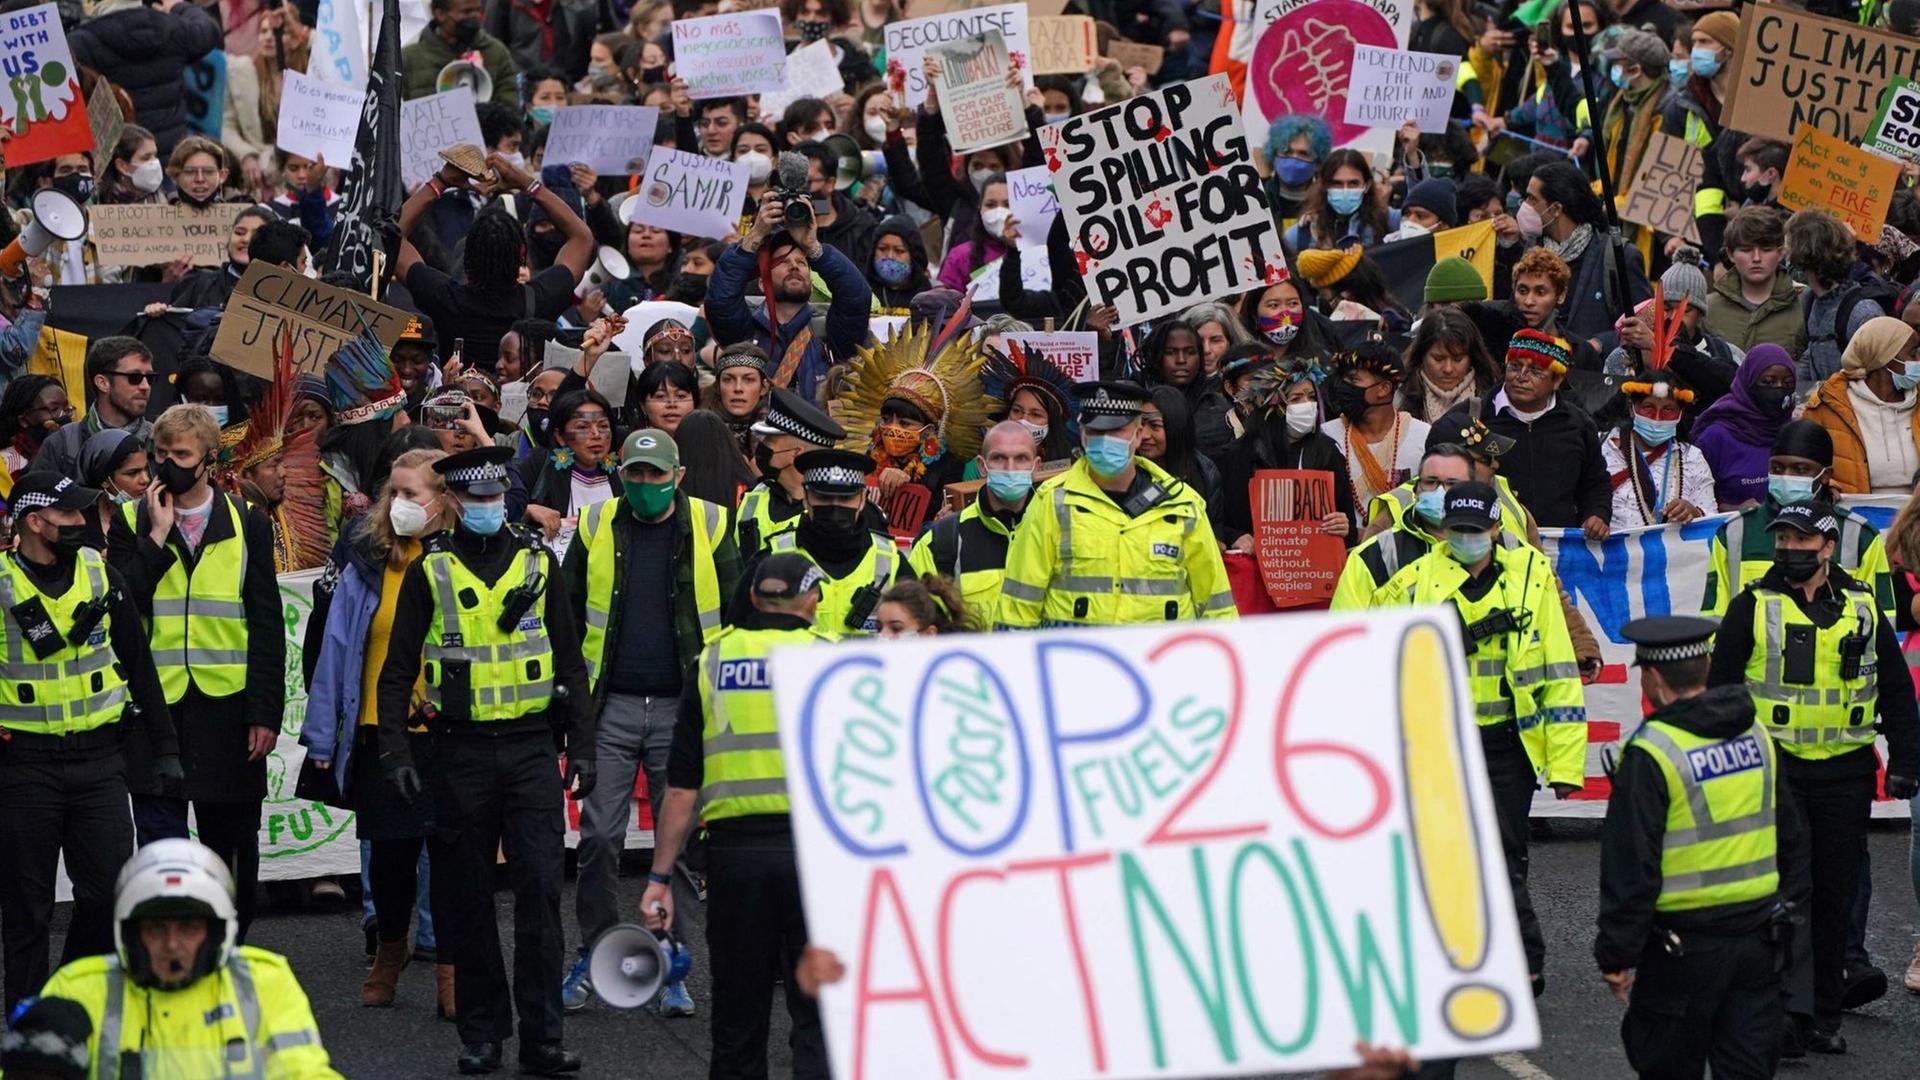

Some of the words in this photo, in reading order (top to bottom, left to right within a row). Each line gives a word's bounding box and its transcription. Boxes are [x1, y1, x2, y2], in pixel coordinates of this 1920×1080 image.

[9, 11, 48, 30] DEBT
[675, 23, 702, 39] No
[888, 11, 1017, 52] DECOLONISE
[4, 30, 49, 50] WITH
[2, 50, 40, 79] US
[1031, 46, 1079, 69] HORA
[1383, 71, 1413, 85] THE
[952, 100, 976, 114] FOR
[1364, 84, 1414, 102] EARTH
[1422, 86, 1447, 100] AND
[400, 96, 451, 127] MATE
[1061, 84, 1192, 163] STOP
[400, 116, 467, 154] UGGLE
[958, 119, 982, 133] FOR
[961, 121, 1014, 143] FUTURE
[1881, 121, 1920, 149] ECO
[1796, 131, 1830, 160] Act
[1069, 115, 1250, 216] SPILLING
[646, 163, 734, 216] SAMIR
[1642, 165, 1696, 205] EGA
[1079, 205, 1166, 261] OIL
[1174, 164, 1269, 233] FOR
[1830, 185, 1878, 216] FIRE
[122, 226, 155, 239] BACK
[157, 225, 175, 238] TO
[182, 223, 219, 237] YOUR
[1095, 220, 1272, 320] PROFIT
[252, 275, 394, 334] CLIMATE
[1451, 498, 1485, 510] POLICE
[1260, 535, 1309, 546] climate
[1261, 525, 1298, 535] There
[1300, 525, 1312, 535] is
[1260, 546, 1302, 557] future
[1262, 558, 1311, 569] without
[1267, 580, 1313, 592] peoples
[720, 661, 772, 687] POLI
[832, 674, 901, 835] STOP
[1072, 695, 1228, 837] FUELS
[1689, 739, 1762, 779] POLICE
[268, 801, 335, 845] FUT
[852, 851, 1114, 1080] ACT
